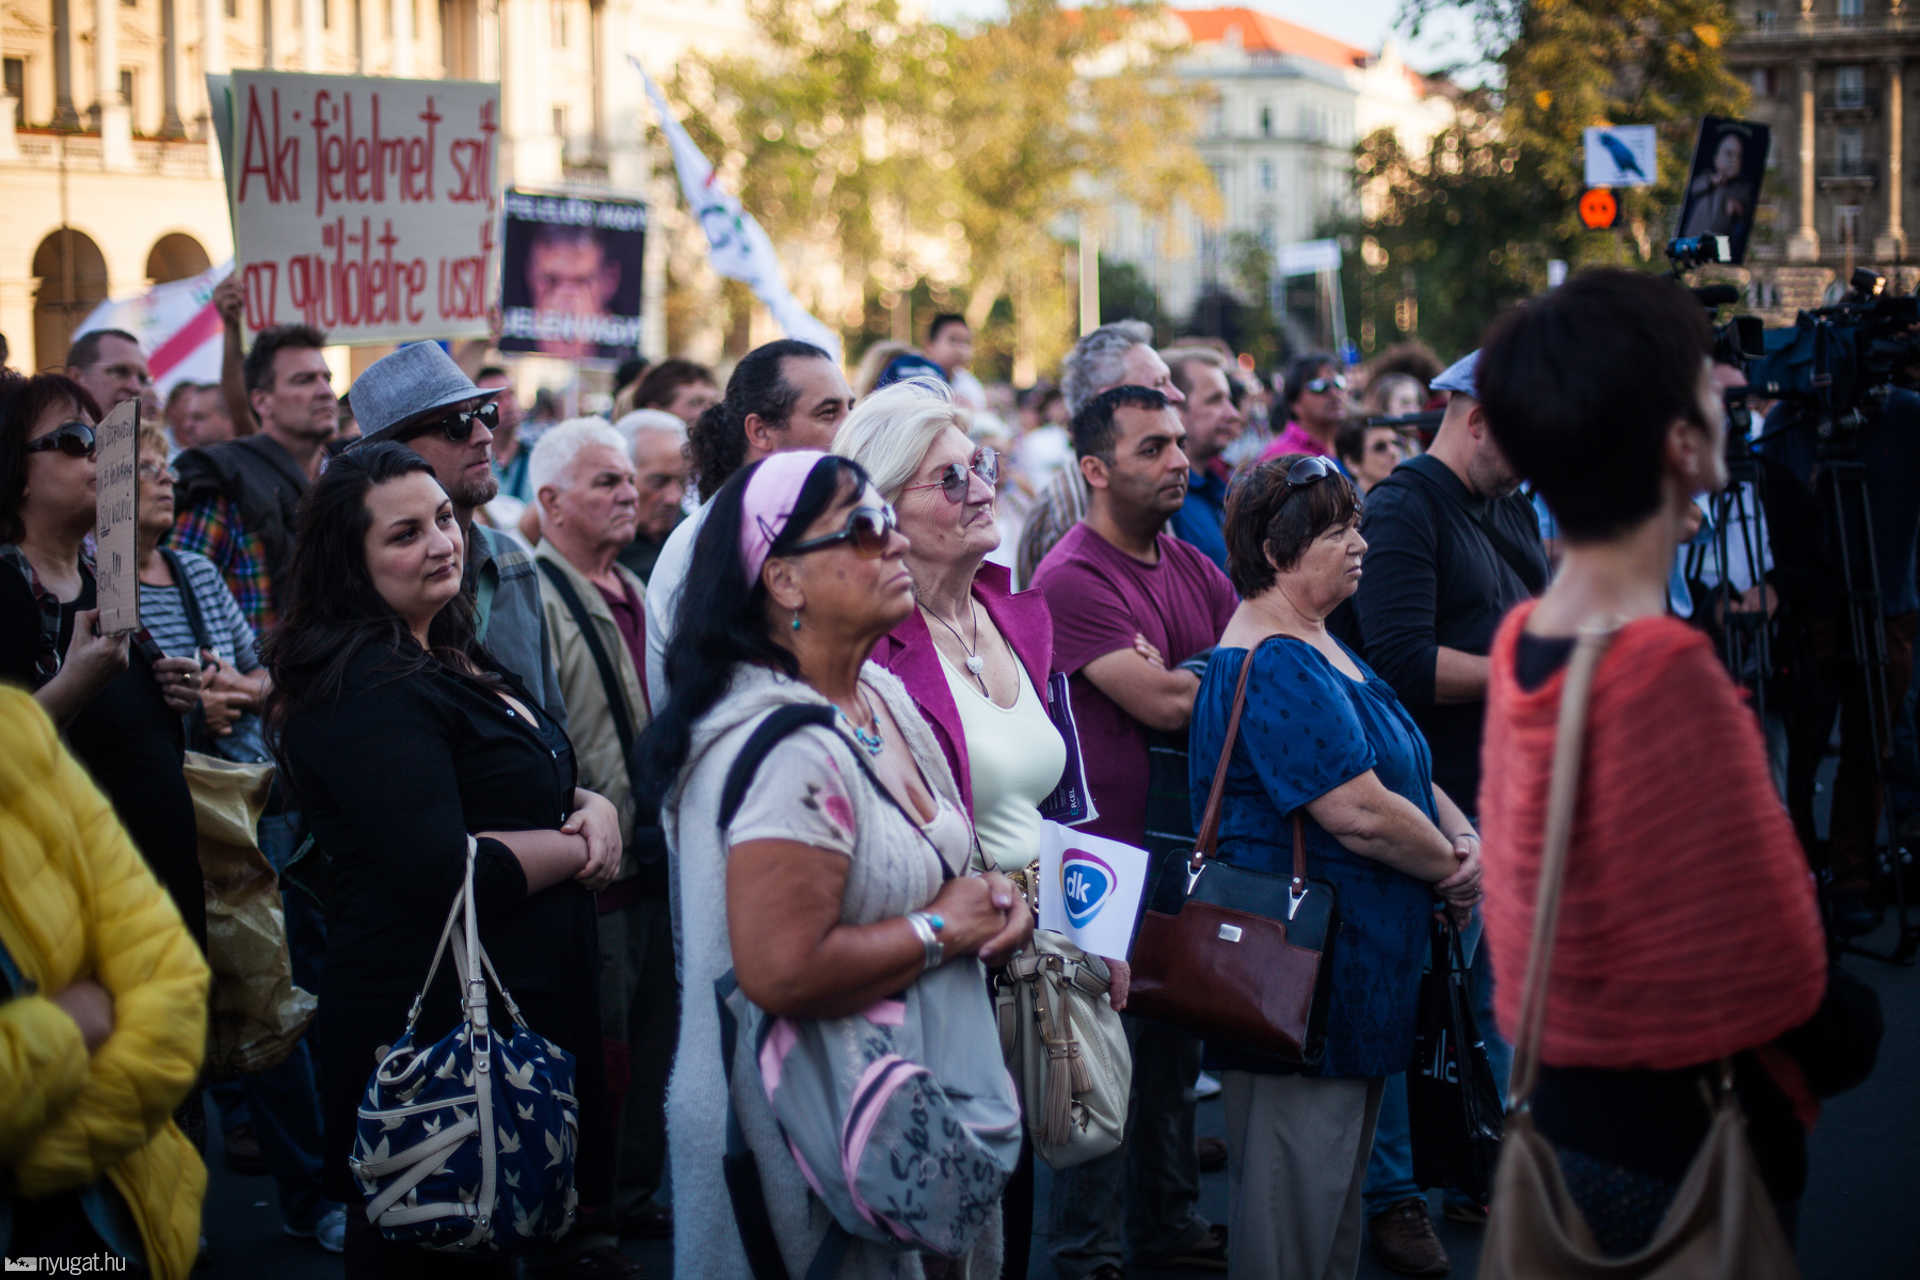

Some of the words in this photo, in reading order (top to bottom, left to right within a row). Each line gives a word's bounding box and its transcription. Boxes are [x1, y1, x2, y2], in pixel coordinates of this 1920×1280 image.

[238, 84, 300, 203] Aki
[244, 260, 278, 332] az
[1066, 871, 1091, 903] dk
